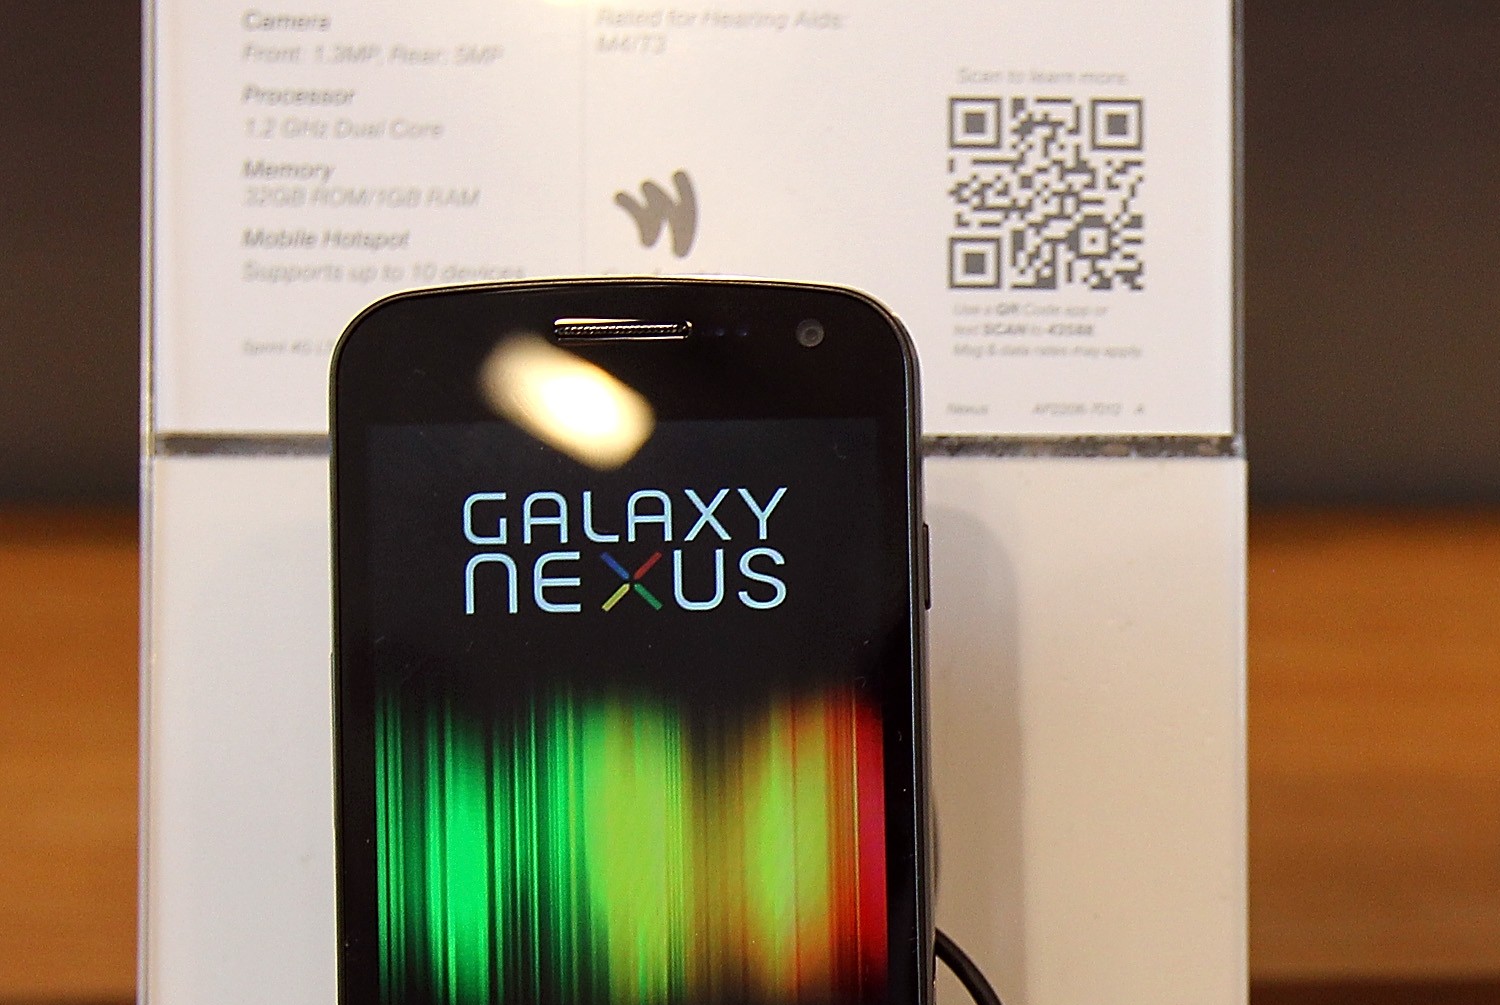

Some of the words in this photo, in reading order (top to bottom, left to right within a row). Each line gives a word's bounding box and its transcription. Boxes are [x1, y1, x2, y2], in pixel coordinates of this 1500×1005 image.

[242, 11, 330, 33] Camera
[242, 86, 355, 107] Processor
[333, 117, 387, 139] Dual
[389, 117, 444, 140] Core
[242, 160, 336, 182] Memory
[242, 229, 317, 250] Mobile
[323, 229, 409, 253] Hotspot
[242, 261, 342, 283] Supports
[347, 263, 375, 283] up
[380, 262, 405, 281] to
[412, 262, 437, 281] 10
[463, 487, 788, 545] GALAXY
[465, 547, 788, 615] NEXUS
